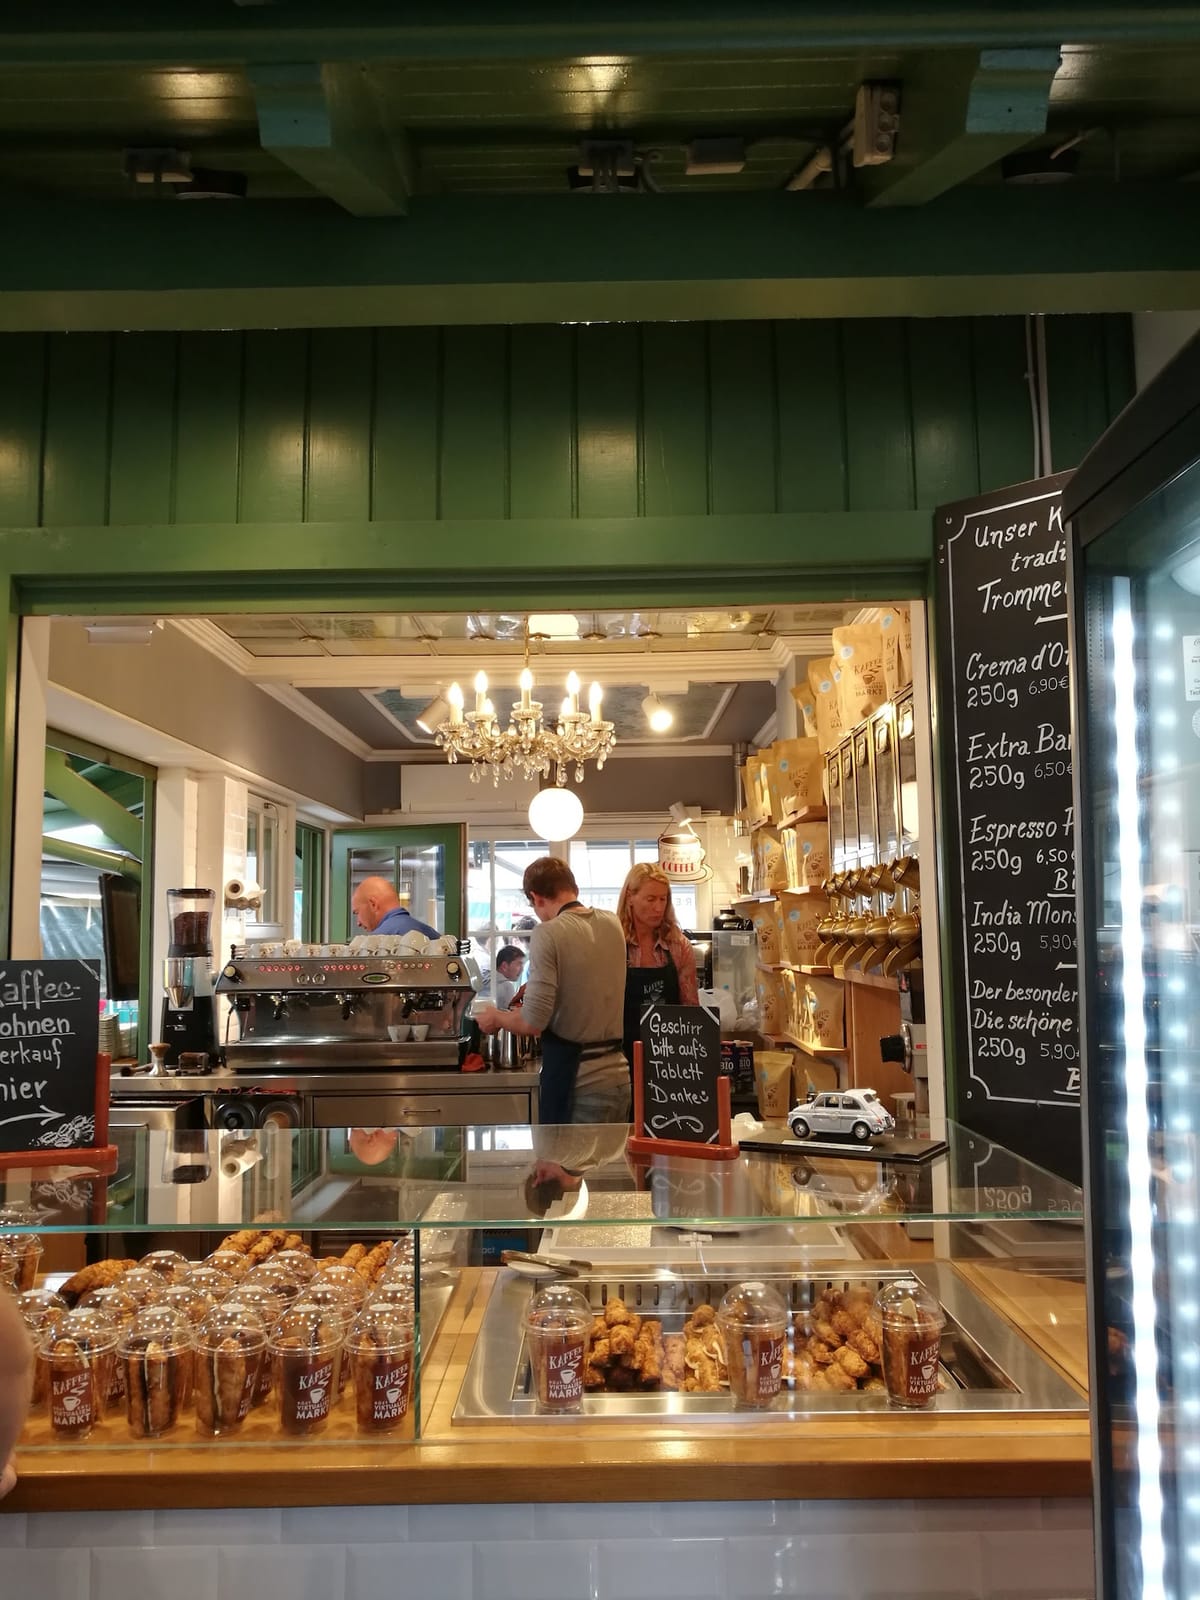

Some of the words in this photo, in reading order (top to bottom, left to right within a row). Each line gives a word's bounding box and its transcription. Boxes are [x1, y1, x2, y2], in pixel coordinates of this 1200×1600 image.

[975, 520, 1038, 549] Unser
[966, 652, 1026, 681] Crema
[967, 682, 1019, 708] 250g
[966, 732, 1031, 762] Extra
[969, 764, 1025, 790] 250g
[969, 814, 1058, 847] Espresso
[971, 848, 1022, 875] 250g
[970, 899, 1022, 927] India
[973, 931, 1021, 961] 250g
[0, 969, 80, 1010] affee-
[971, 980, 1003, 999] Der
[0, 1012, 70, 1037] ohnen
[649, 1012, 703, 1037] Geschirr
[972, 1008, 1005, 1029] Die
[1008, 1009, 1073, 1038] schöne
[0, 1038, 62, 1069] erkauf
[650, 1036, 675, 1057] bitte
[678, 1038, 708, 1060] auf's
[978, 1037, 1026, 1066] 250g
[649, 1060, 704, 1080] Tablett
[648, 1080, 701, 1104] Danke
[54, 1412, 91, 1425] MARKT
